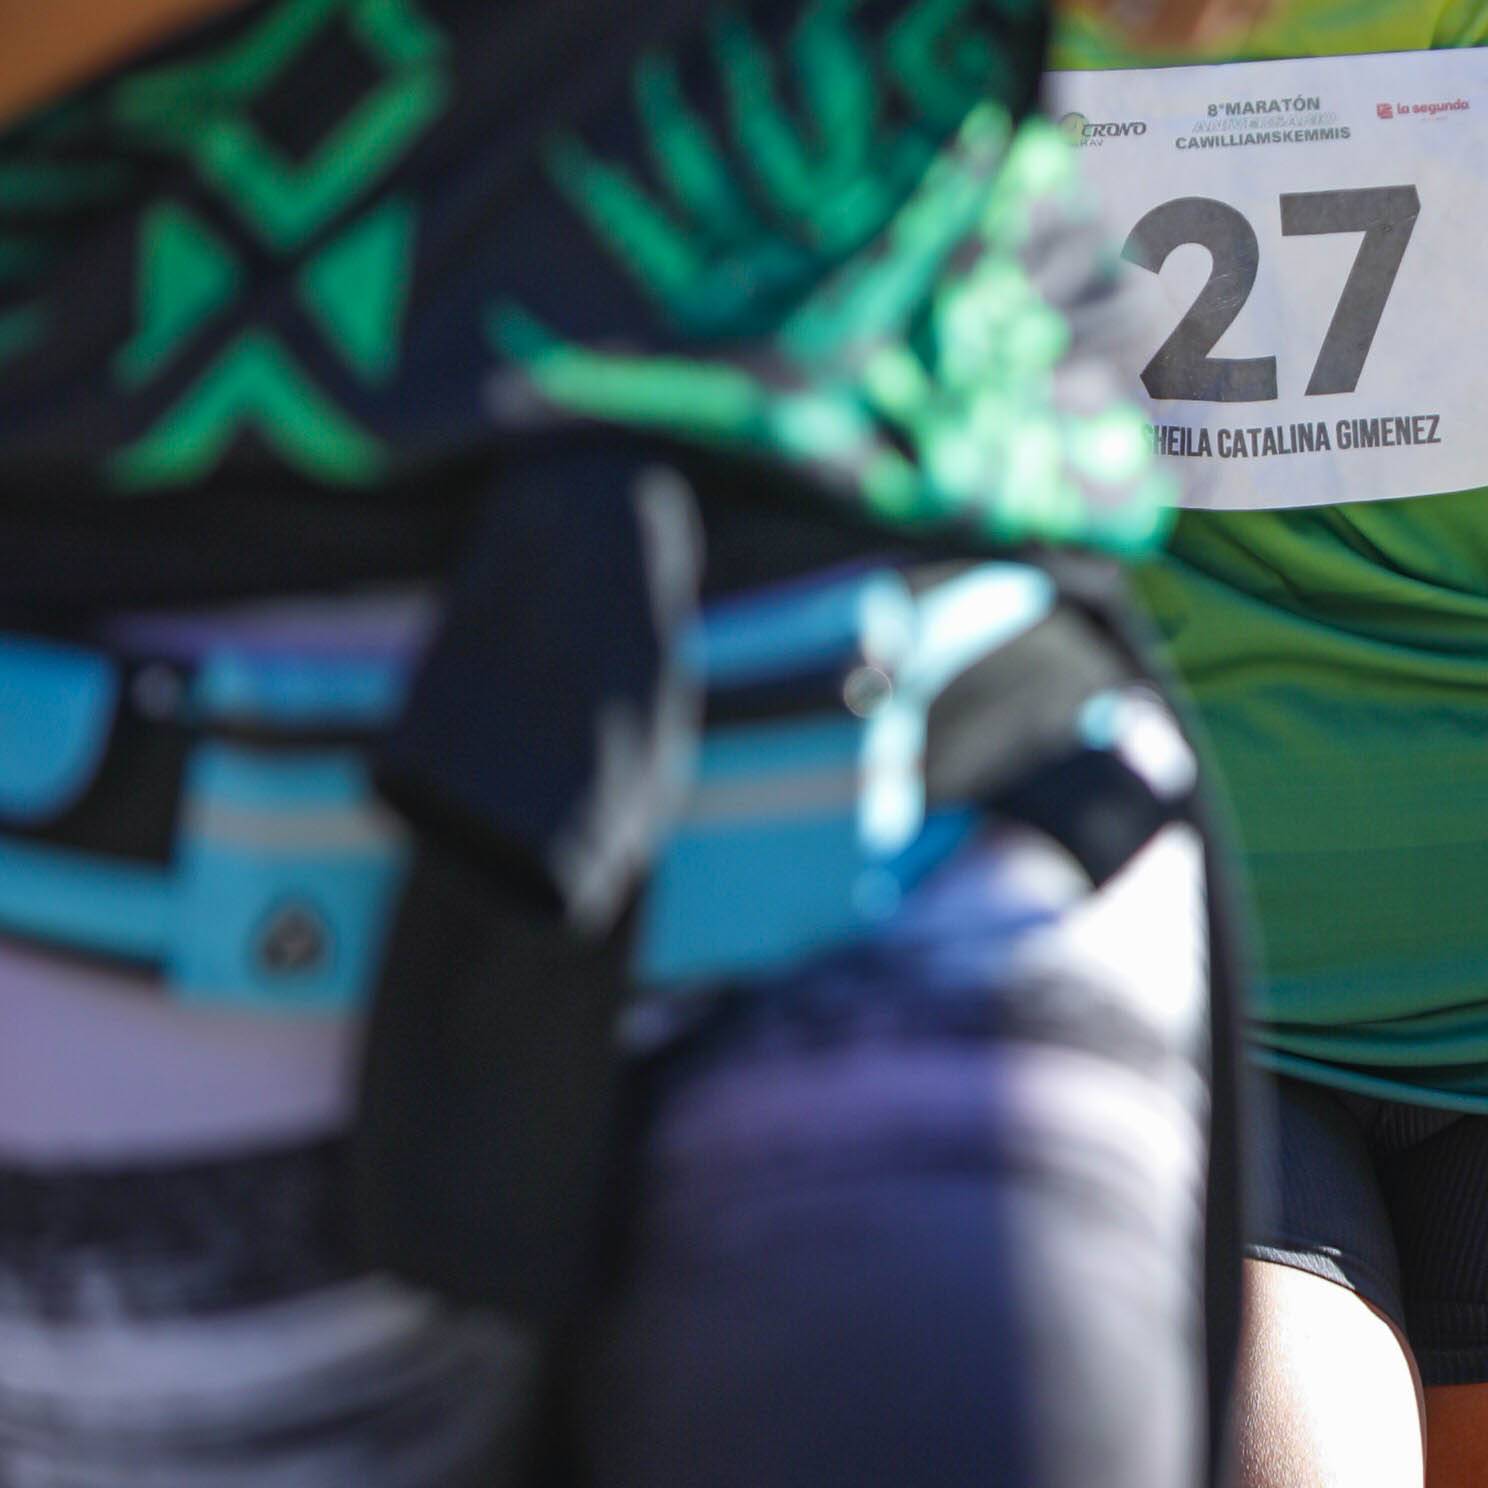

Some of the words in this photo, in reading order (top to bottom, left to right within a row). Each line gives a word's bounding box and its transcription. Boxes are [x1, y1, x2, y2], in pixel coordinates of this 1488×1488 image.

[1397, 102, 1410, 114] la
[1412, 98, 1469, 115] segunda
[1175, 126, 1351, 150] CAWILLIAMSKEMMIS
[1120, 184, 1421, 403] 27
[1217, 421, 1331, 459] CATALINA
[1336, 414, 1441, 450] GIMENEZ
